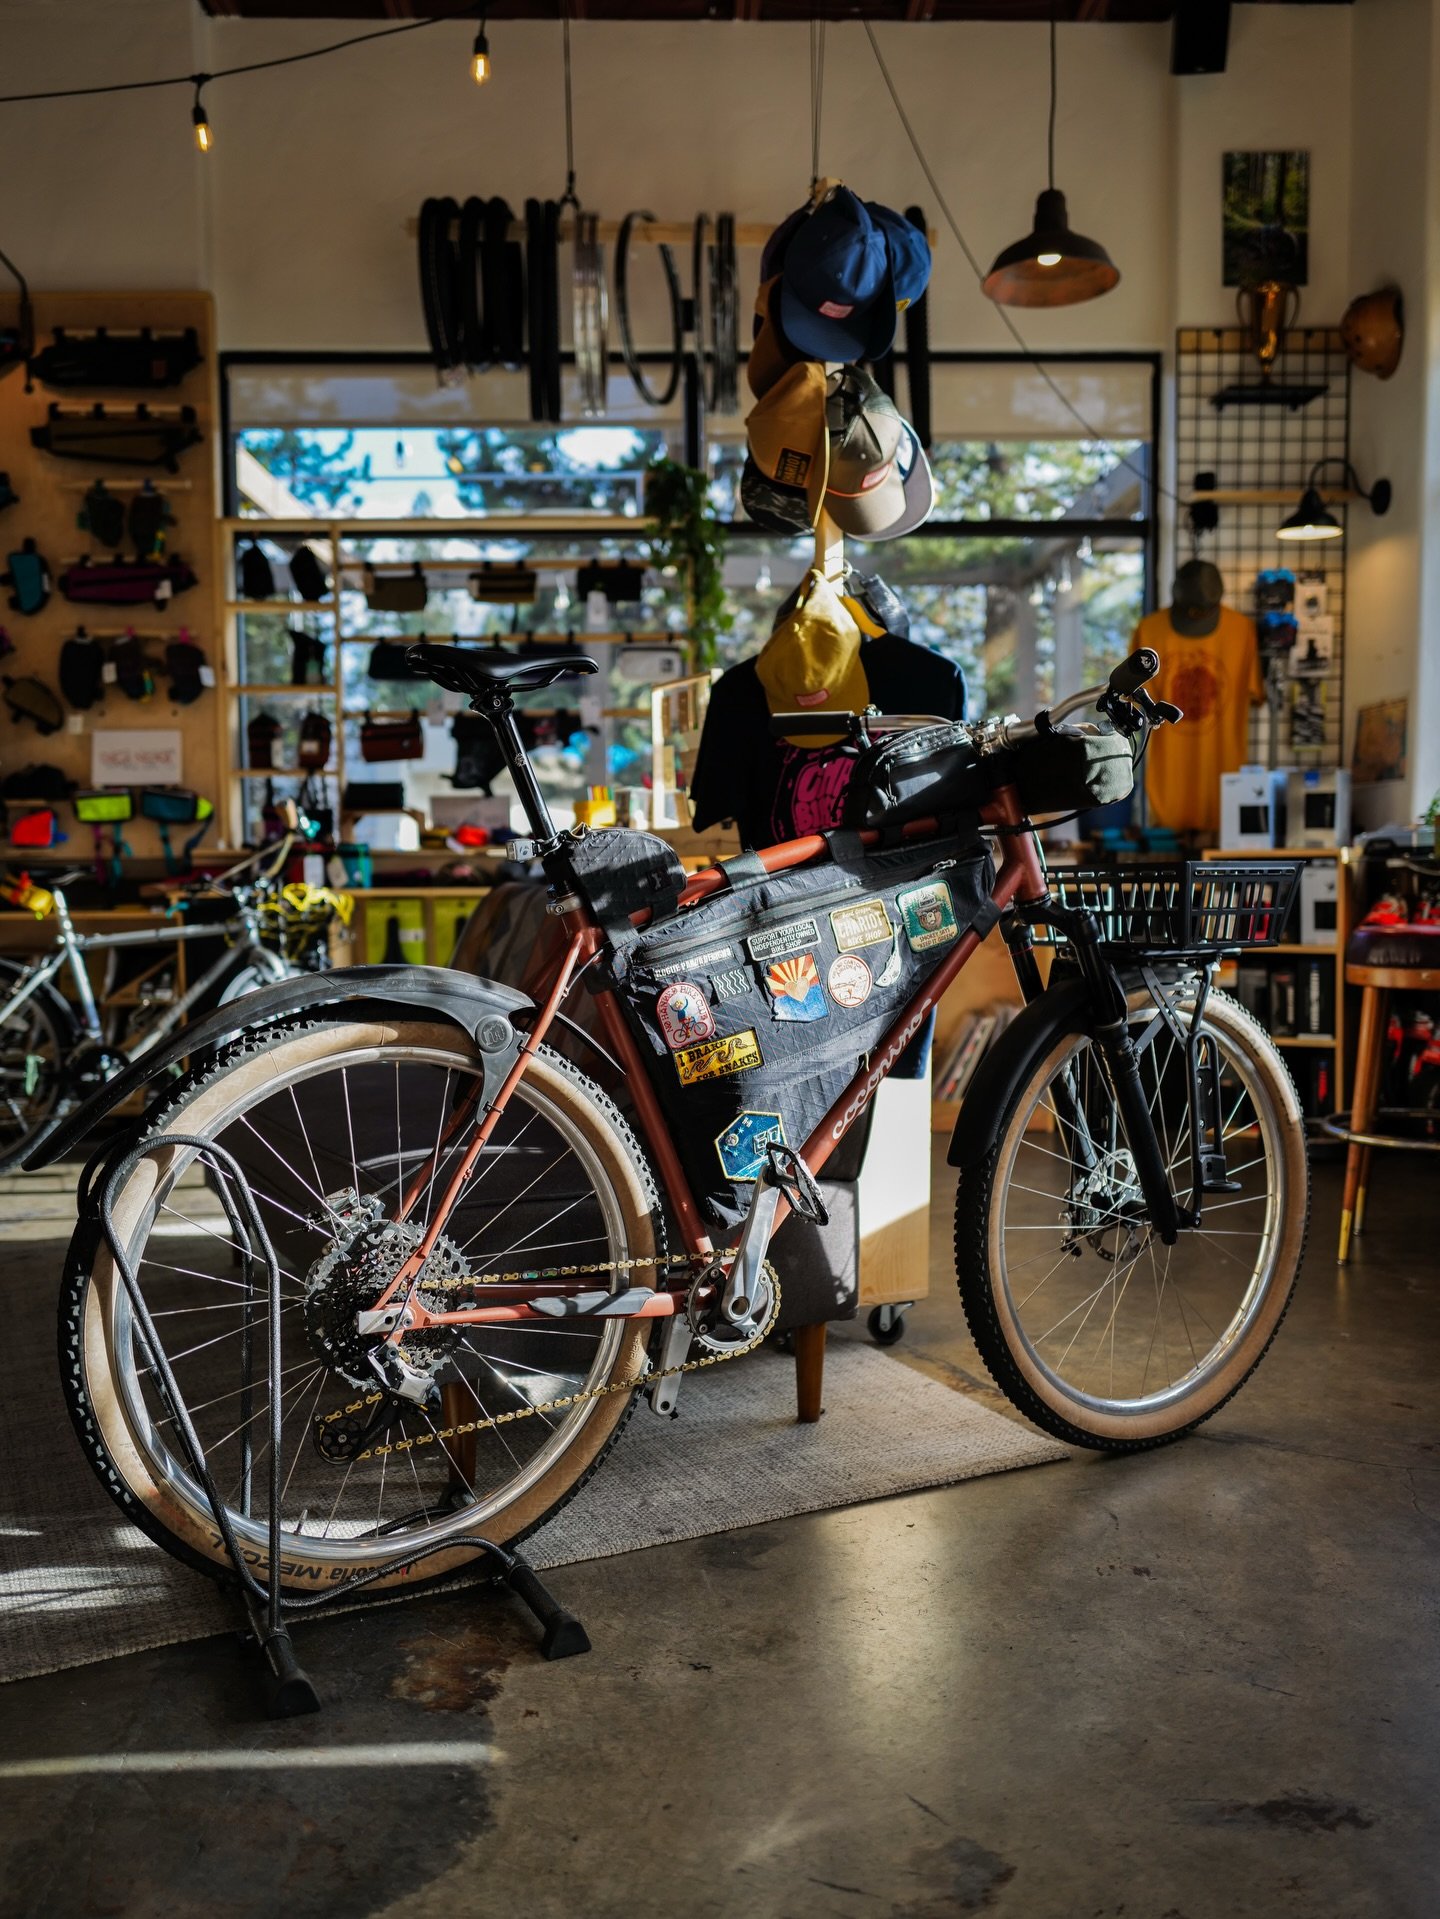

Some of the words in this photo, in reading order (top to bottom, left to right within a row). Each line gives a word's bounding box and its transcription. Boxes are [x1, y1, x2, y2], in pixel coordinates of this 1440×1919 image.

[751, 931, 778, 945] SUPPORT
[779, 926, 795, 936] YOUR
[794, 921, 813, 931] LOCAL
[834, 911, 883, 938] CHARIOT
[752, 934, 796, 952] INDEPENDENTLY
[795, 928, 815, 939] OWNED
[771, 945, 786, 954] BIKE
[786, 939, 802, 949] SHOP
[847, 936, 864, 947] BIKE
[865, 930, 882, 941] SHOP
[654, 962, 681, 978] ROGUE
[680, 985, 699, 1000] BIKE
[696, 1000, 708, 1021] CLUB
[677, 1052, 685, 1067] I
[688, 1040, 727, 1063] BRAKE
[696, 1069, 717, 1081] FOR
[718, 1051, 760, 1075] SNAKES
